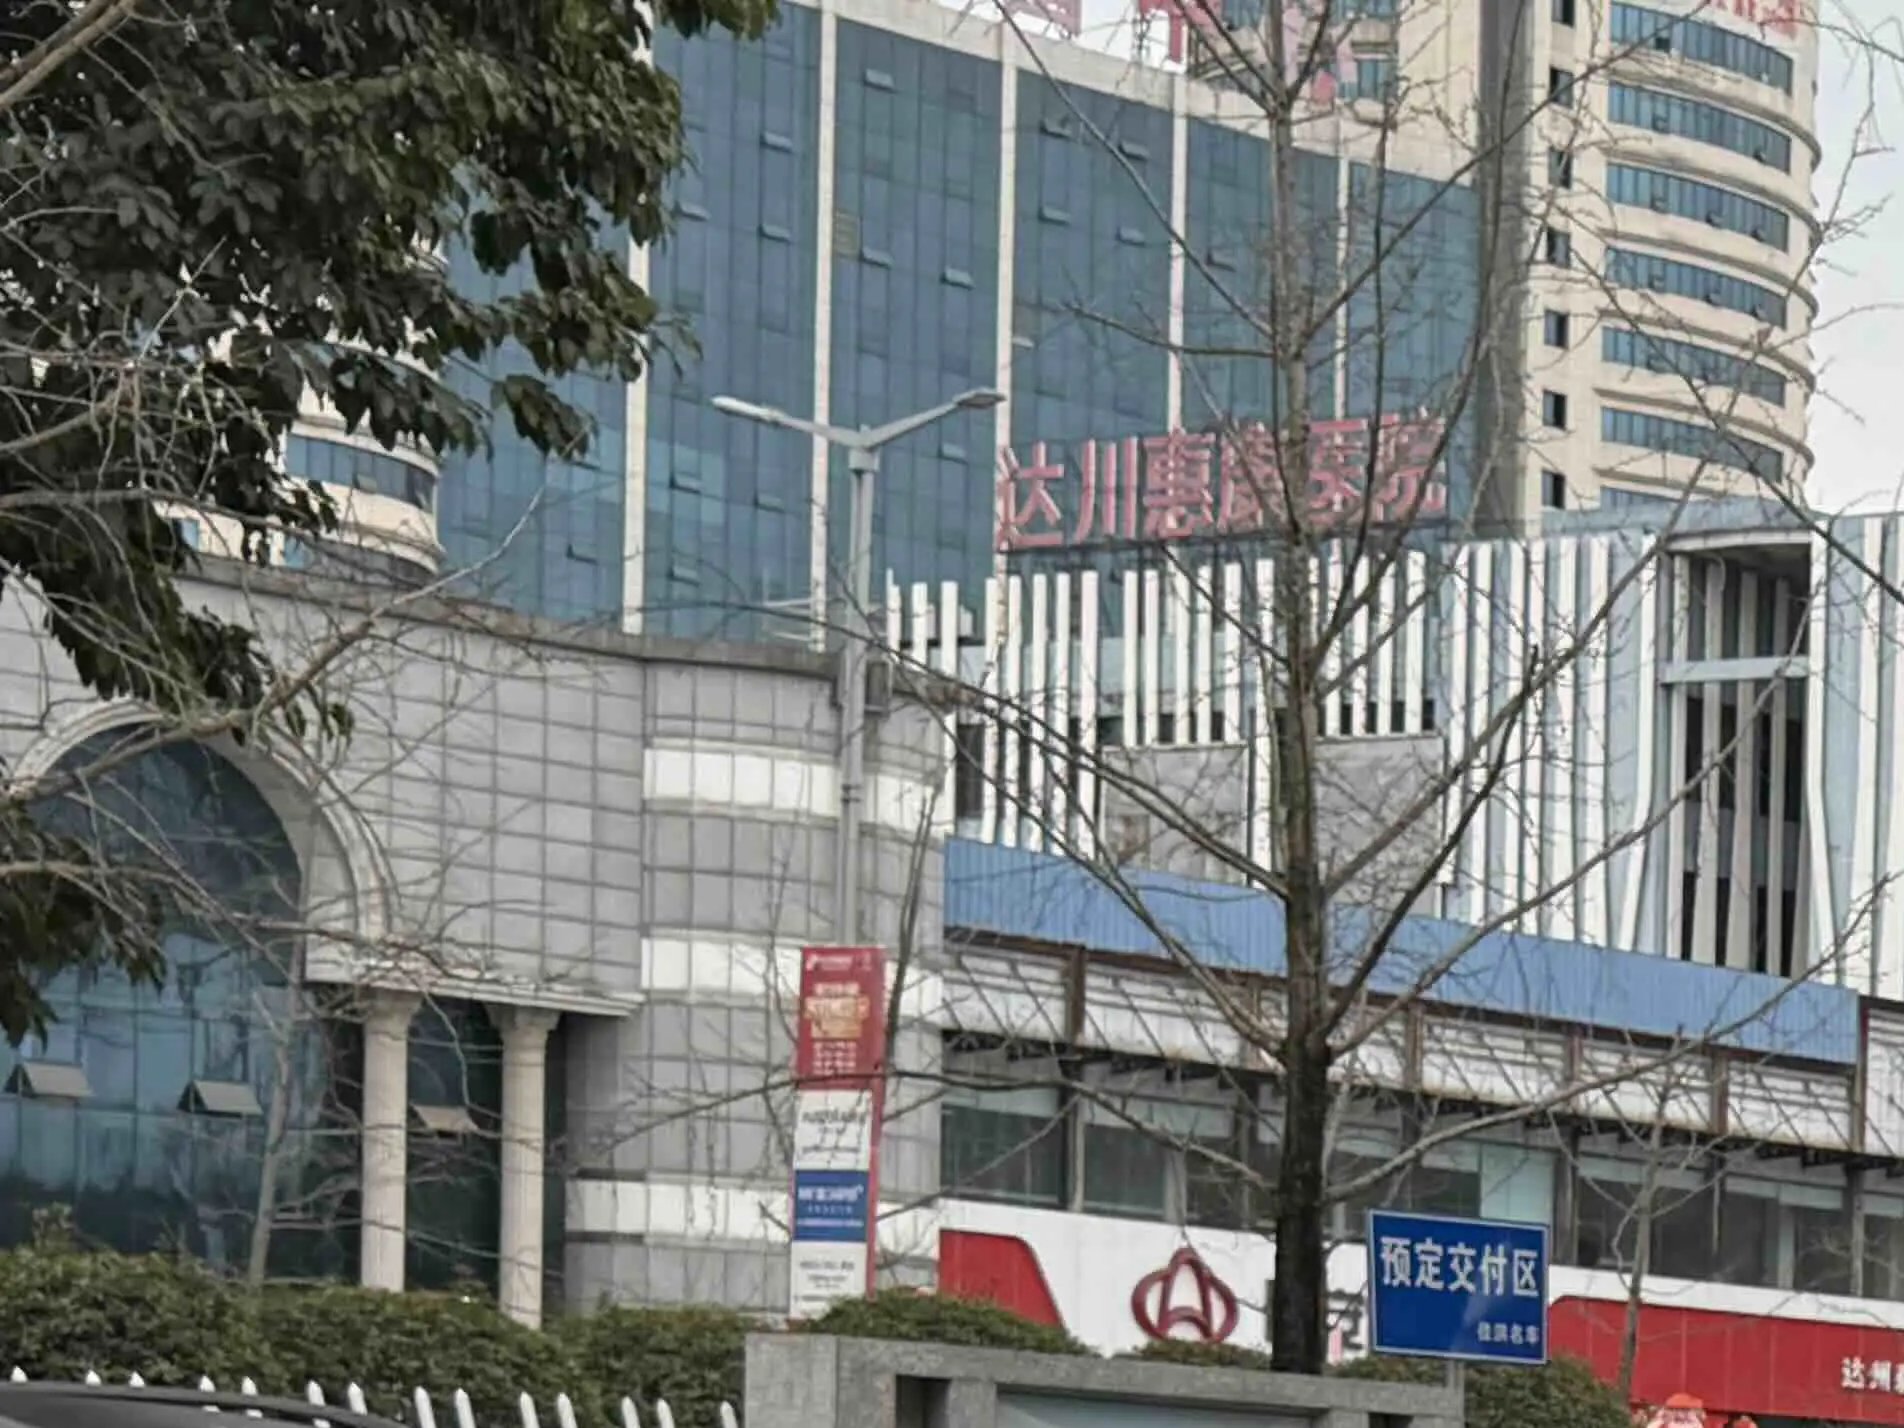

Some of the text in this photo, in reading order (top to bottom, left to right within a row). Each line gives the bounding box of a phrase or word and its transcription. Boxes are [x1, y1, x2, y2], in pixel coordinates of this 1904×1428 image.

[1380, 1235, 1540, 1298] 预定交付区
